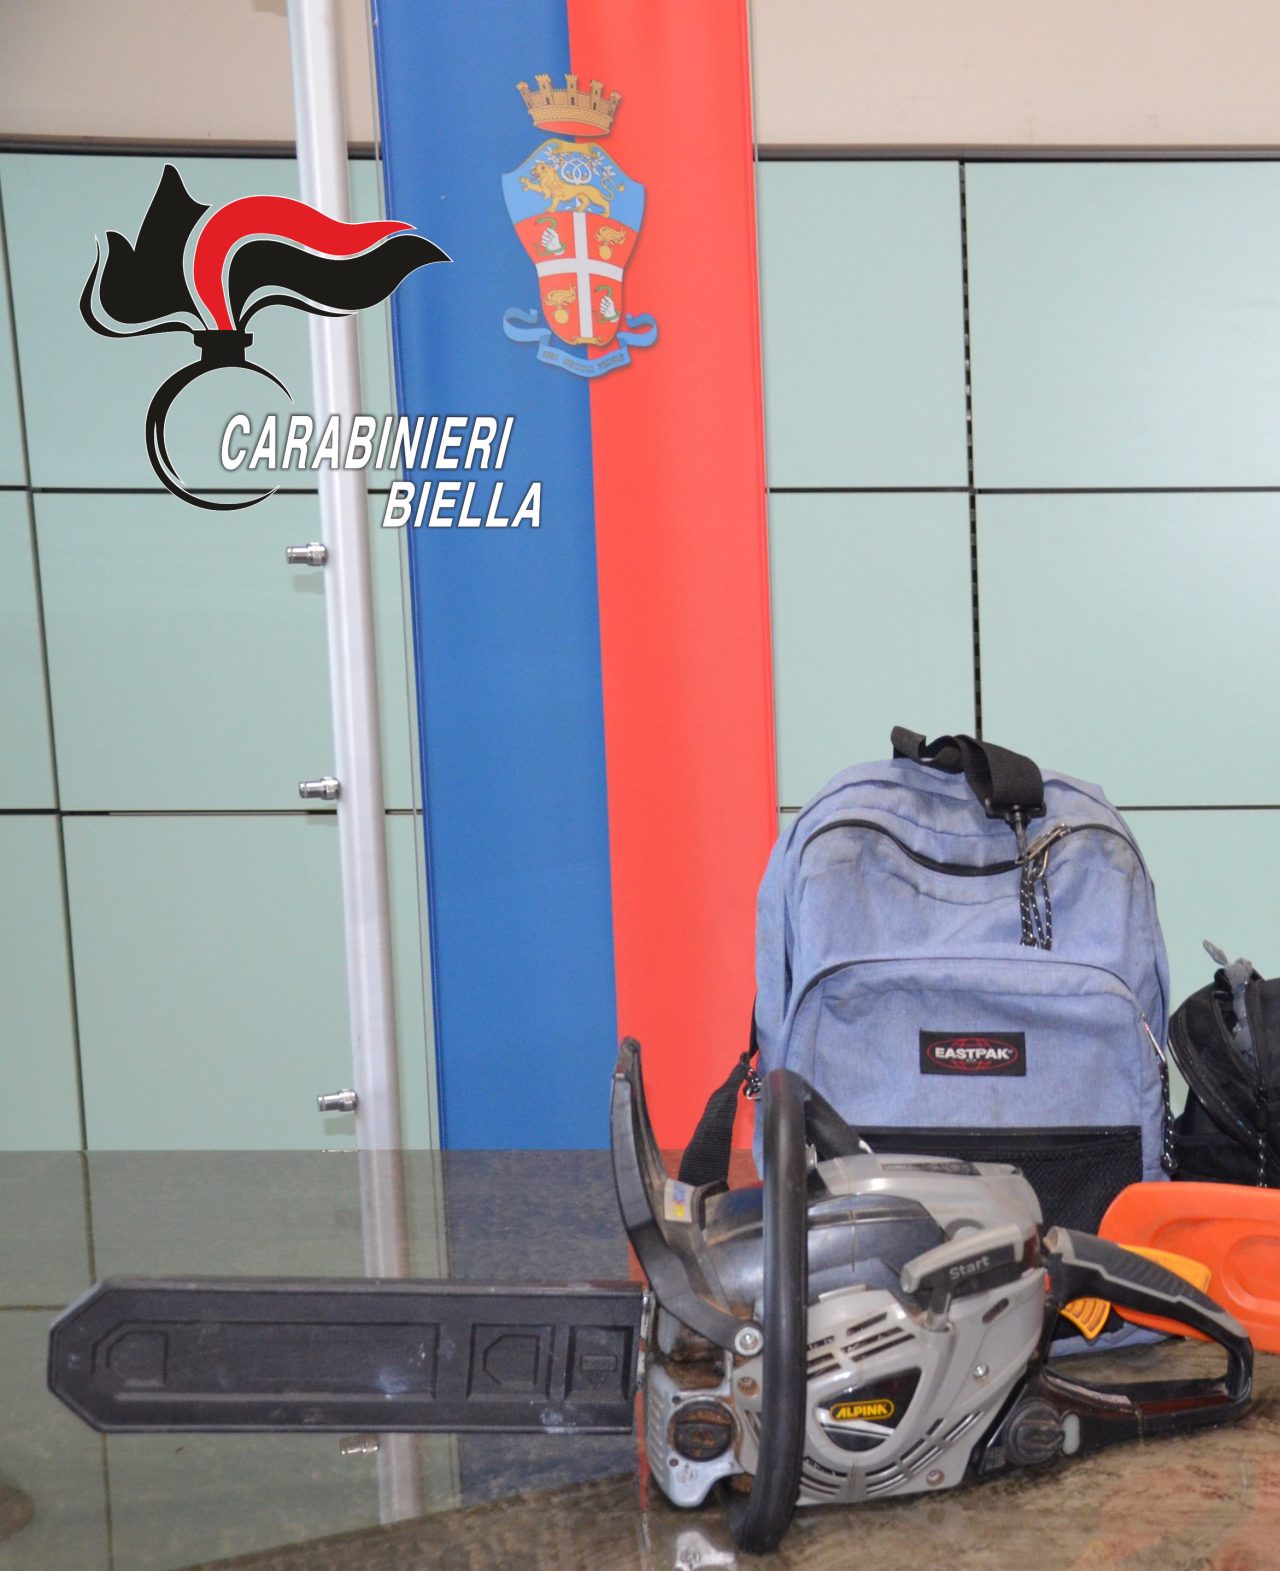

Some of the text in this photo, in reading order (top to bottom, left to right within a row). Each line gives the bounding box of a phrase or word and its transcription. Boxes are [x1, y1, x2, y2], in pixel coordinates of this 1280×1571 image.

[934, 1047, 1010, 1060] EASTPAK
[949, 1255, 990, 1280] Start
[836, 1403, 888, 1419] ALPINA
